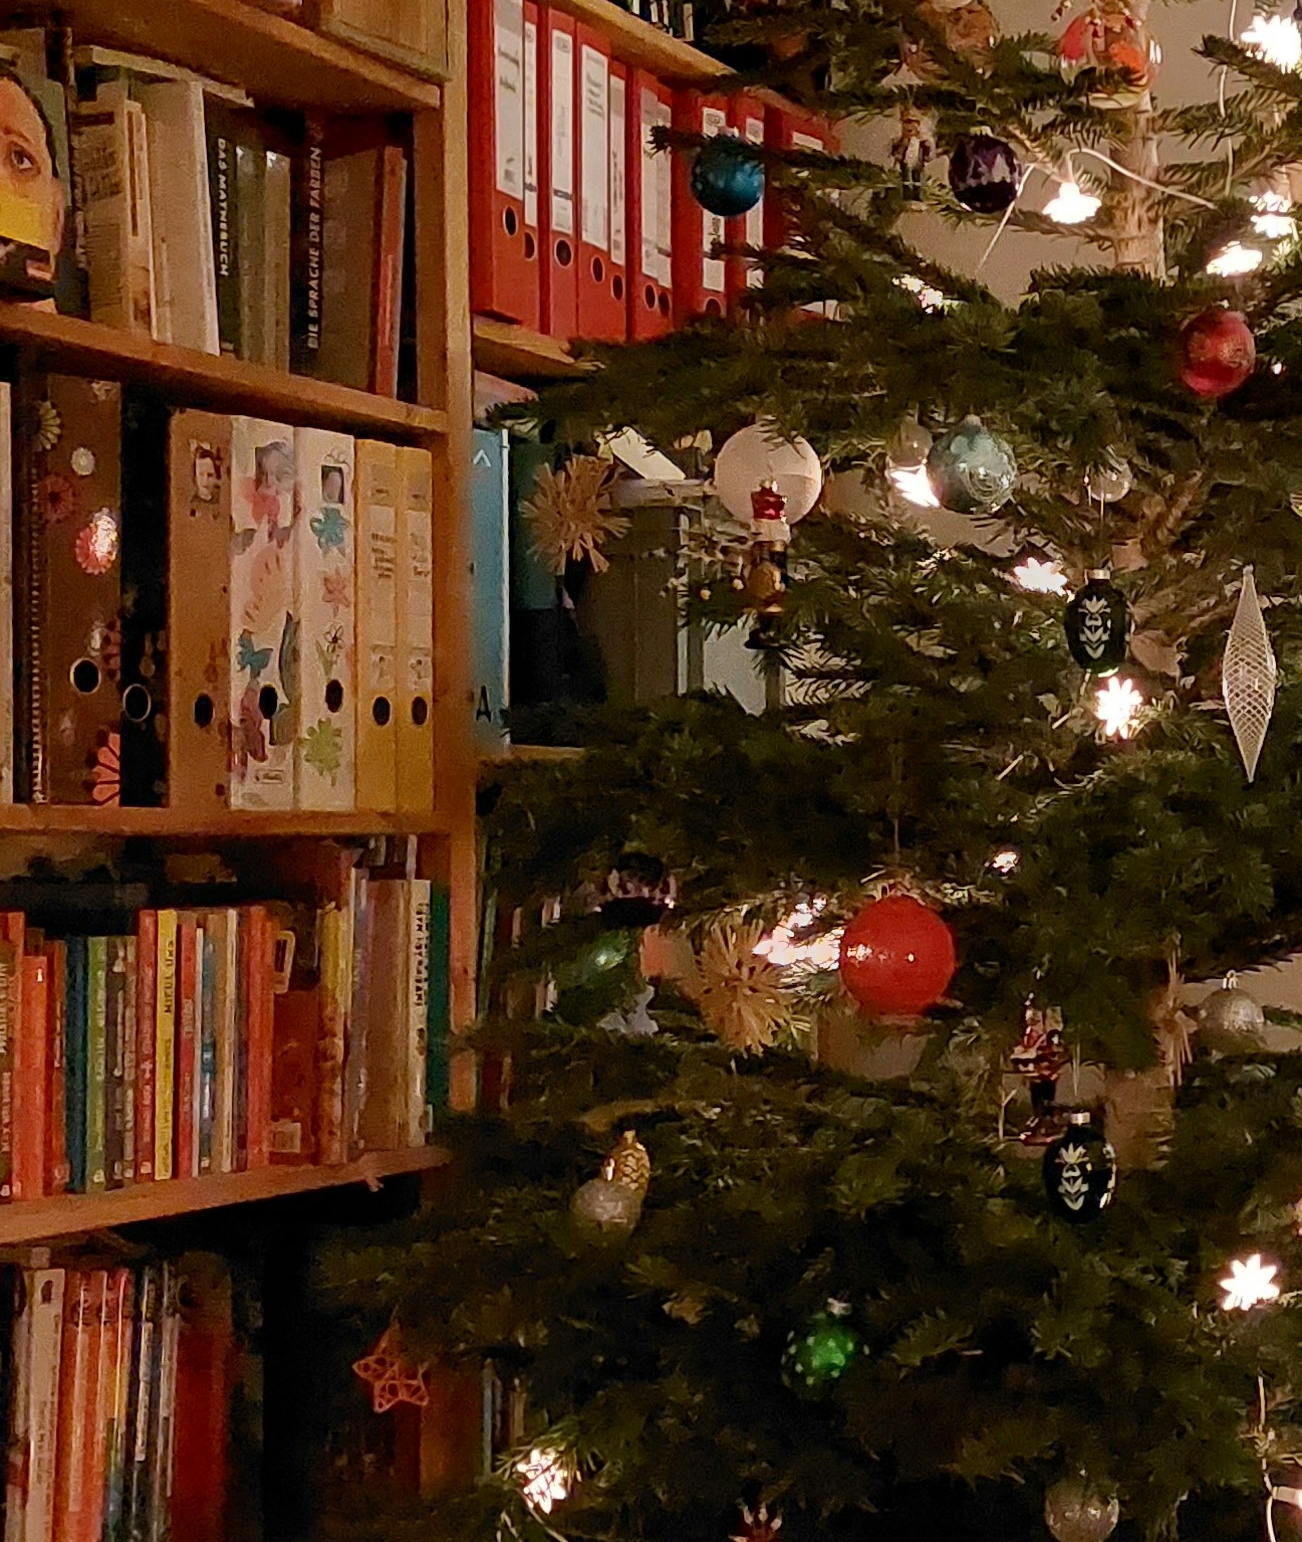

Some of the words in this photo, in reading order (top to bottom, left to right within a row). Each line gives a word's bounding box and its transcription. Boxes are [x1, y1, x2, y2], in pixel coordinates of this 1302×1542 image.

[218, 137, 228, 171] DAS
[309, 146, 323, 210] FARBEN
[309, 212, 321, 243] DER
[308, 248, 320, 318] SPRACHE
[308, 323, 319, 350] DIE
